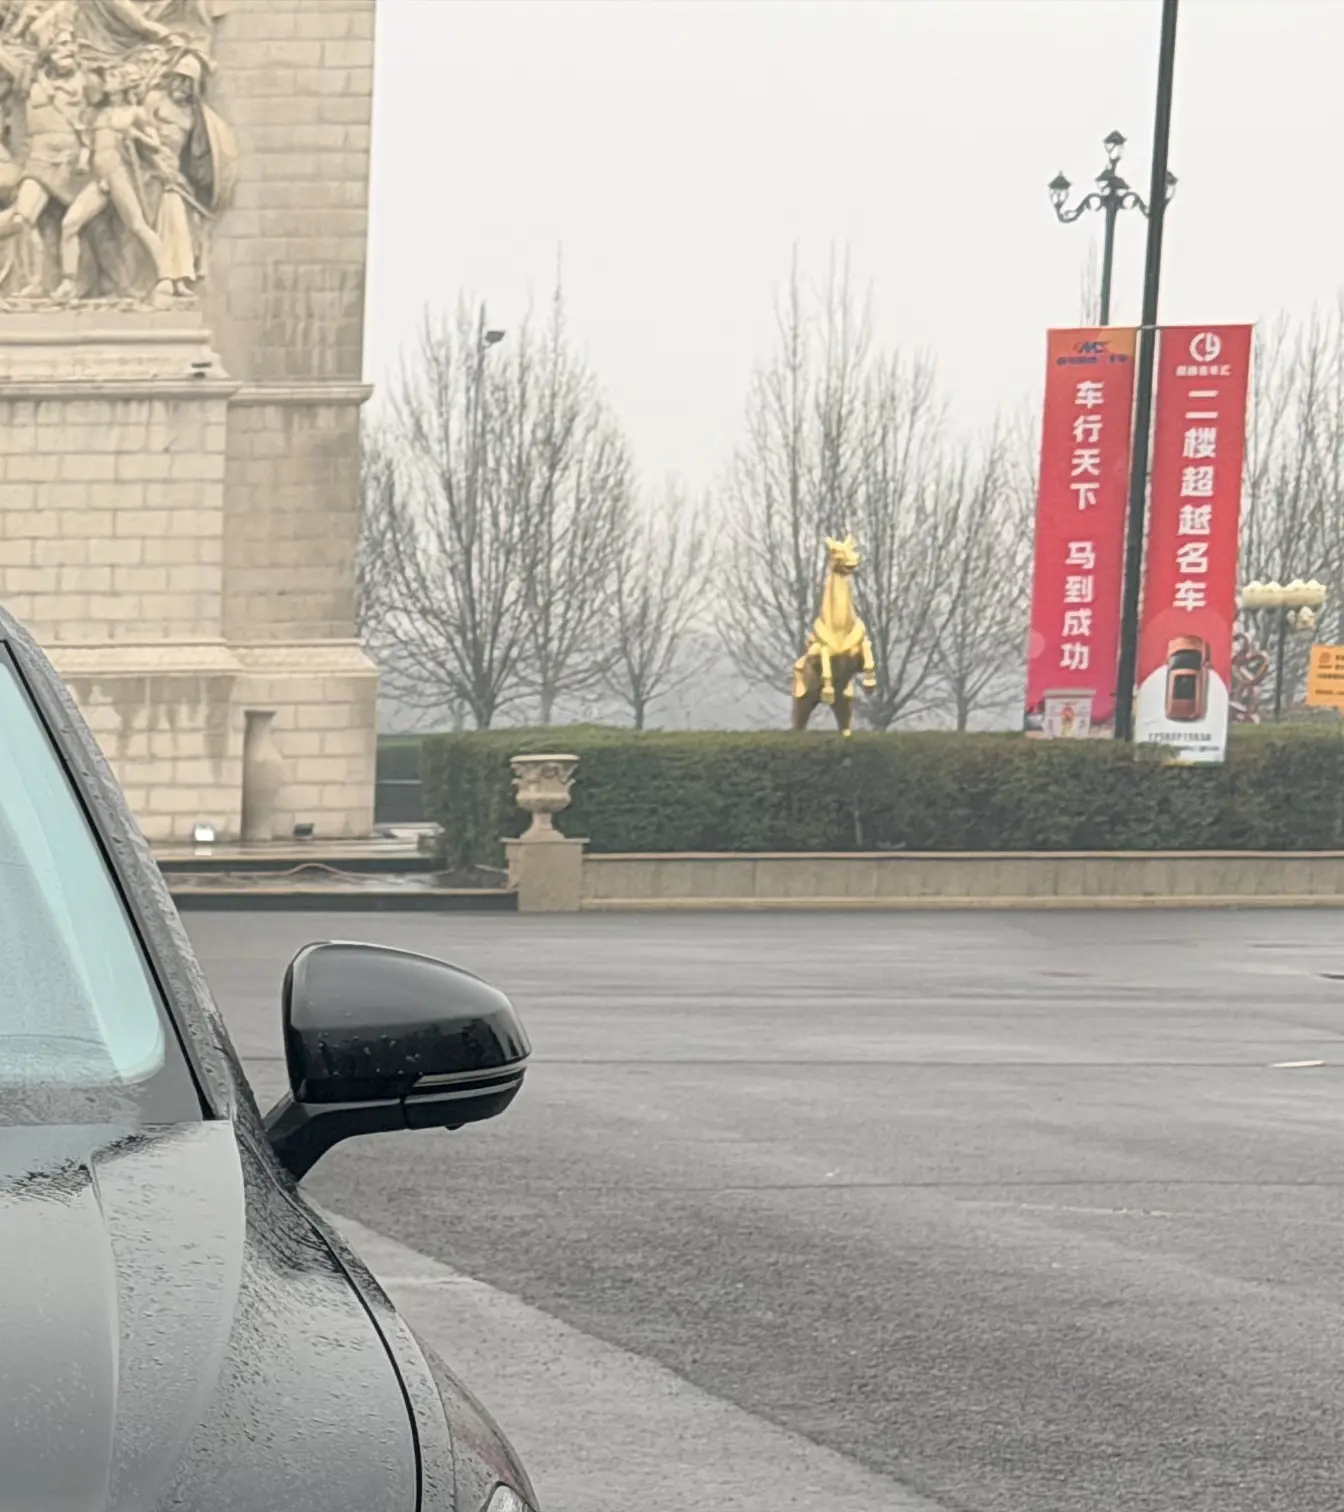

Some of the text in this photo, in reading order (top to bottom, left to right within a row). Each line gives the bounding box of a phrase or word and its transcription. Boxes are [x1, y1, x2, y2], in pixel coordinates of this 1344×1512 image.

[1070, 380, 1104, 510] 车行天下
[1172, 390, 1219, 611] 二楼超越名车
[1059, 541, 1096, 670] 马到成功
